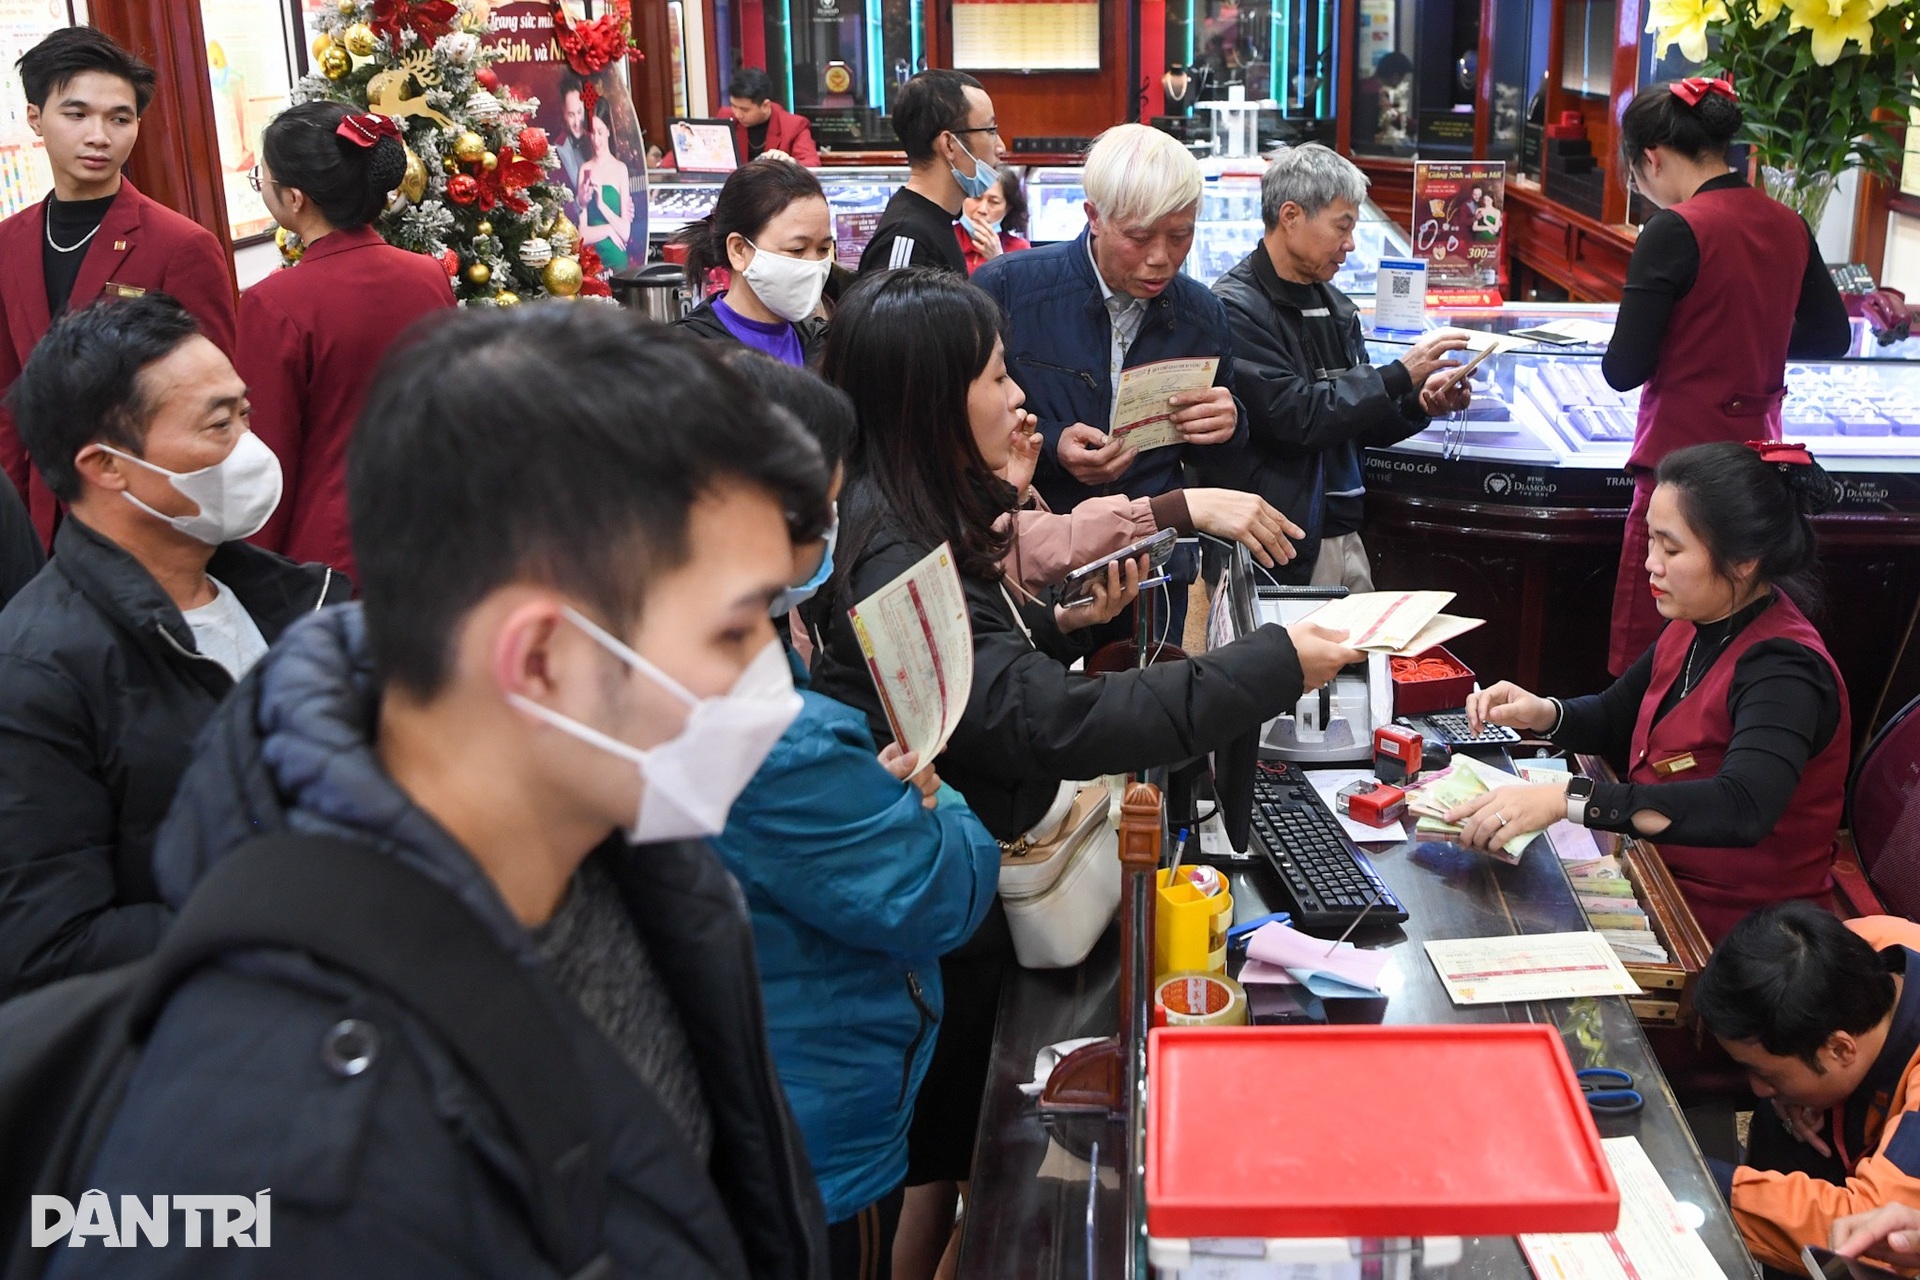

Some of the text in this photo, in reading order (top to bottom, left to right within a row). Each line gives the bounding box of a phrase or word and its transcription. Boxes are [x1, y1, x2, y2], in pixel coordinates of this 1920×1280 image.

[488, 11, 518, 33] Trang
[519, 11, 537, 29] sức
[497, 37, 532, 64] Sinh
[534, 42, 549, 62] và
[1449, 171, 1464, 179] Sinh
[1467, 247, 1488, 259] 300
[1393, 461, 1416, 473] CAO
[1416, 462, 1438, 475] CẤP
[1514, 481, 1557, 493] DIAMOND
[1605, 476, 1636, 486] TRAN
[1846, 488, 1889, 499] DIAMOND
